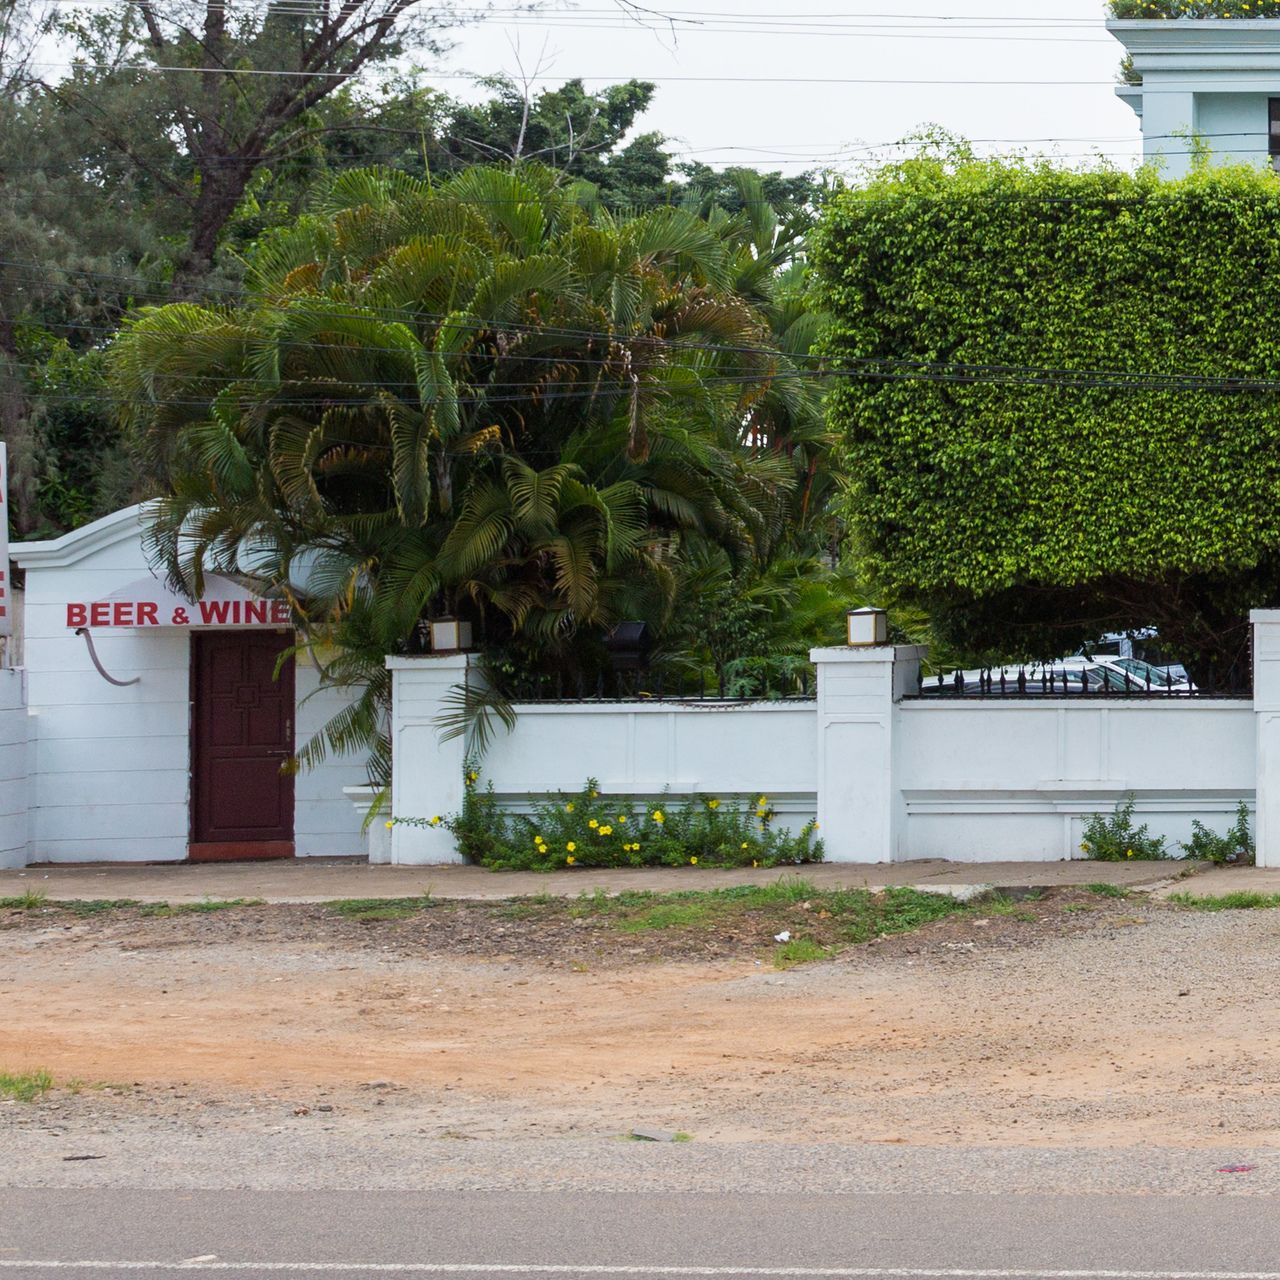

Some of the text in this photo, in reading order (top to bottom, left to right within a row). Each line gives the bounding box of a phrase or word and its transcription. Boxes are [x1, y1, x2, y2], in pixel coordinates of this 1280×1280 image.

[67, 599, 291, 628] BEER & WINE
